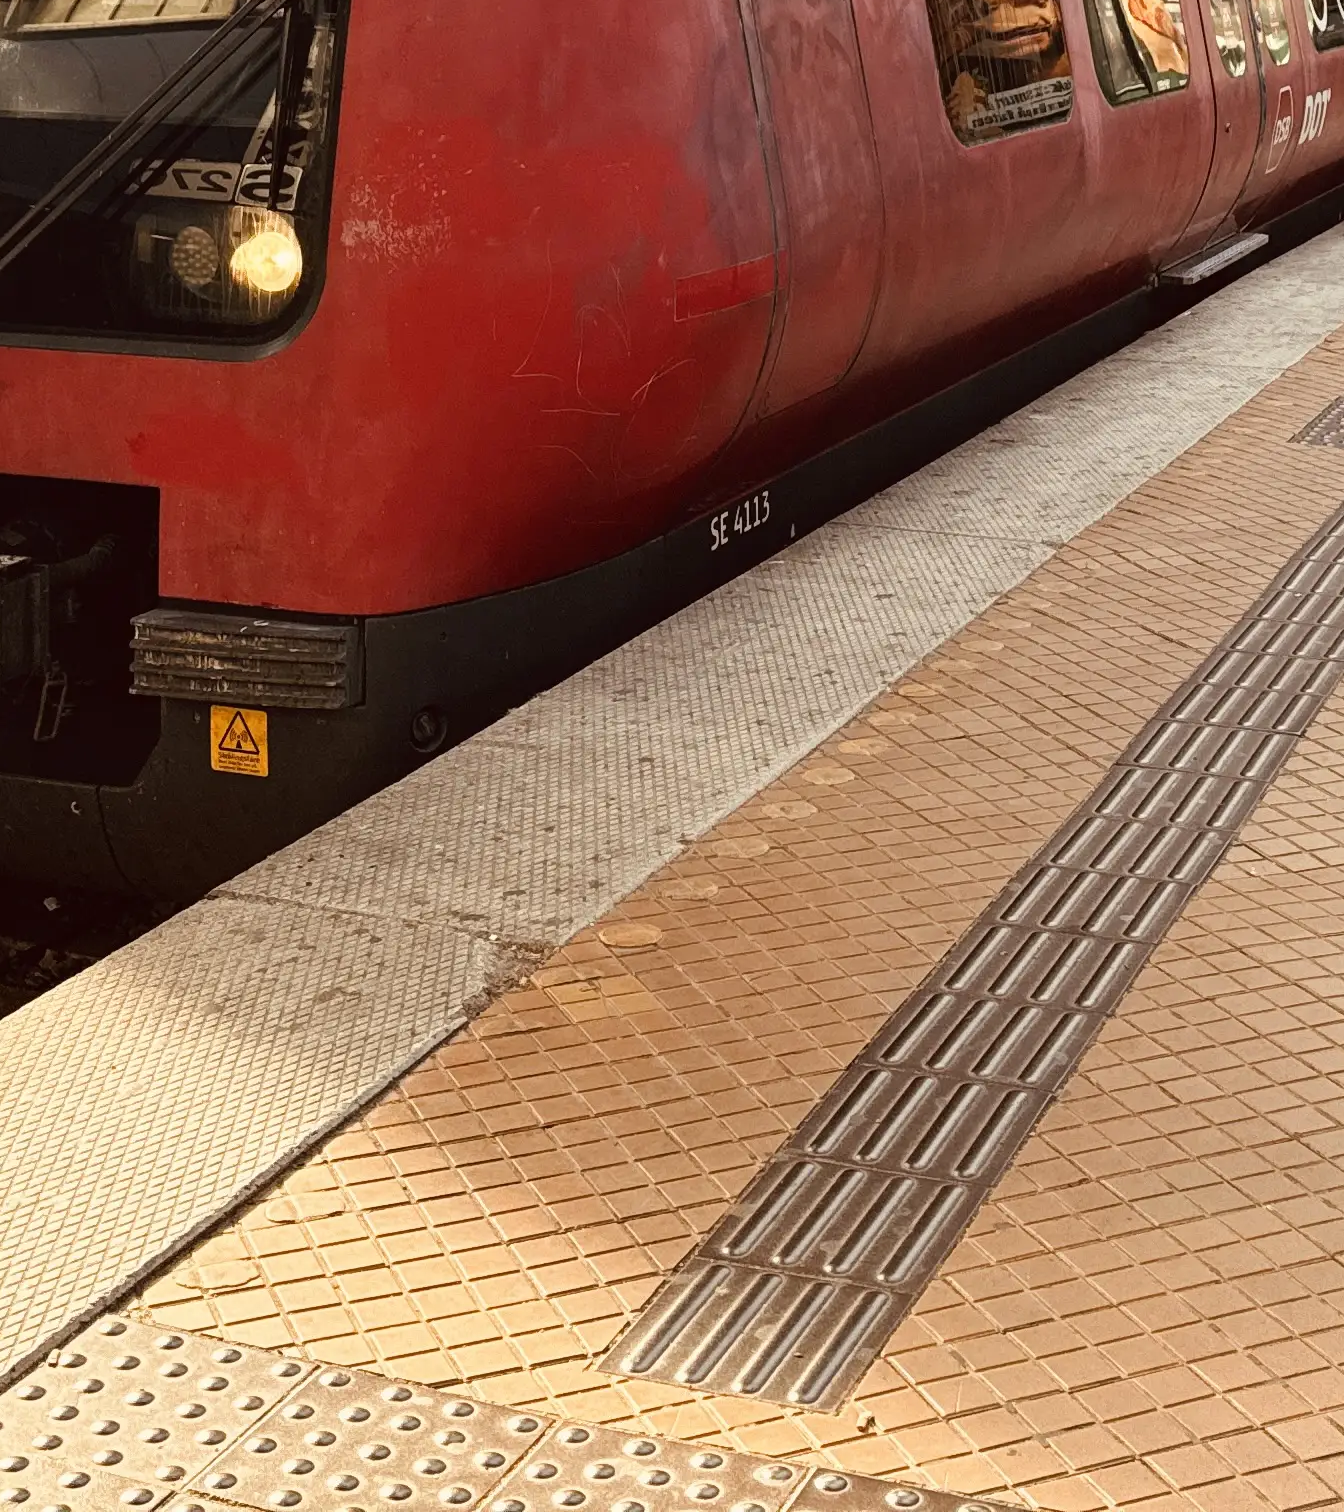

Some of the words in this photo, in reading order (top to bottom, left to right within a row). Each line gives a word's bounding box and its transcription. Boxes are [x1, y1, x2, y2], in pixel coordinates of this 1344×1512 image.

[1273, 115, 1292, 146] DSB
[1297, 87, 1332, 146] DOT
[710, 510, 729, 552] SE
[733, 490, 770, 535] 4113
